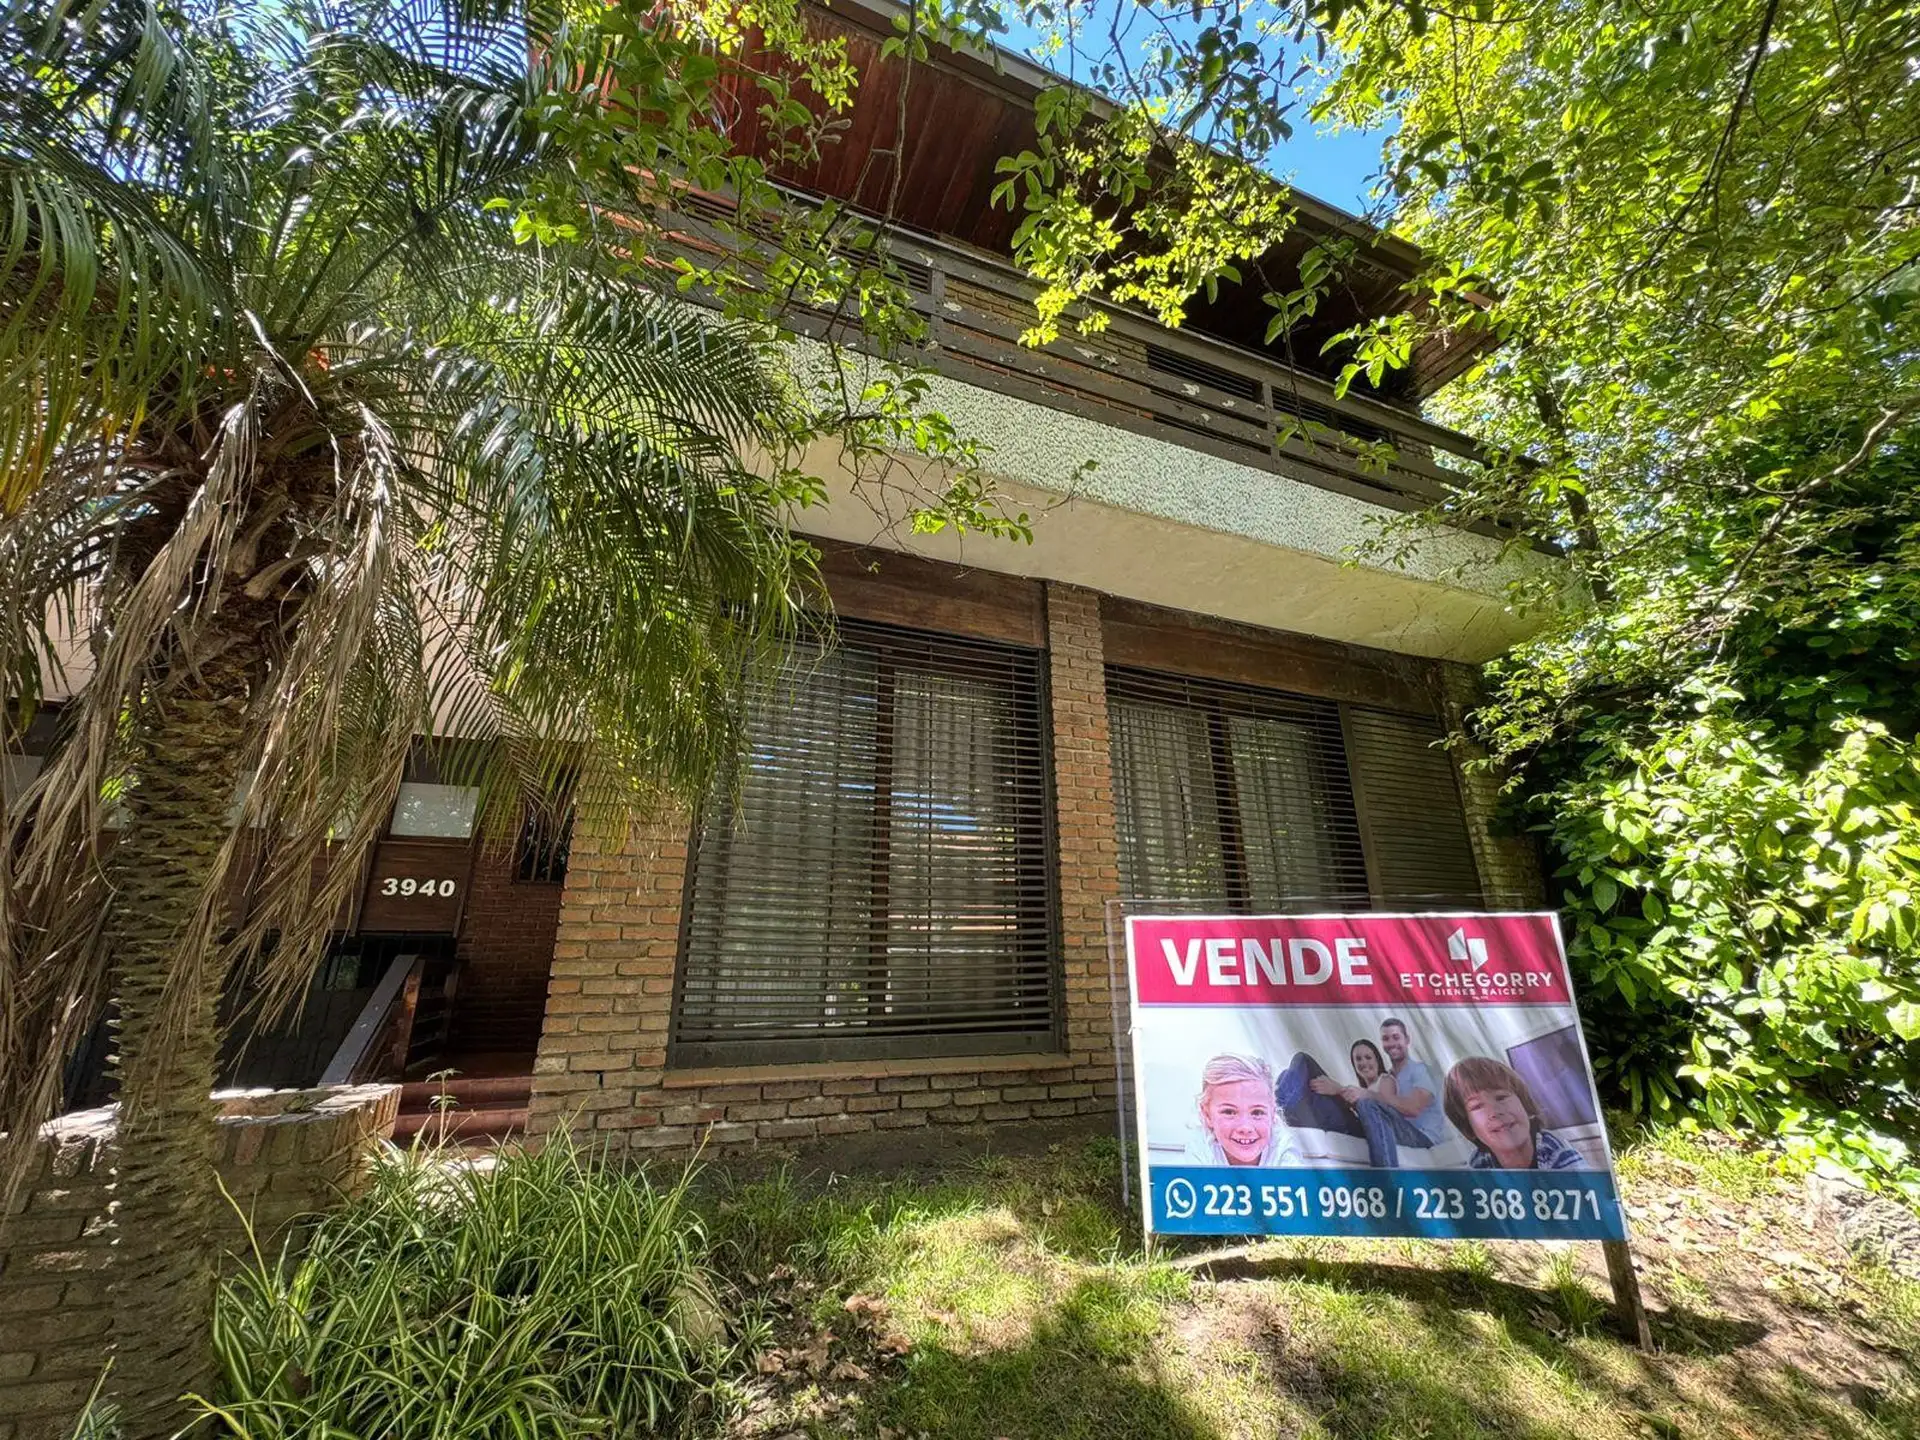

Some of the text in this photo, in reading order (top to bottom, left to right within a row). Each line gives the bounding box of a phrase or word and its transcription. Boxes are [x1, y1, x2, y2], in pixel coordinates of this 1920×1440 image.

[381, 878, 456, 897] 3940
[1159, 937, 1374, 986] VENDE
[1400, 972, 1552, 988] ETCHEGORRY
[1434, 988, 1476, 996] BIENES
[1203, 1184, 1602, 1221] 223 551 9968 / 223 368 8271
